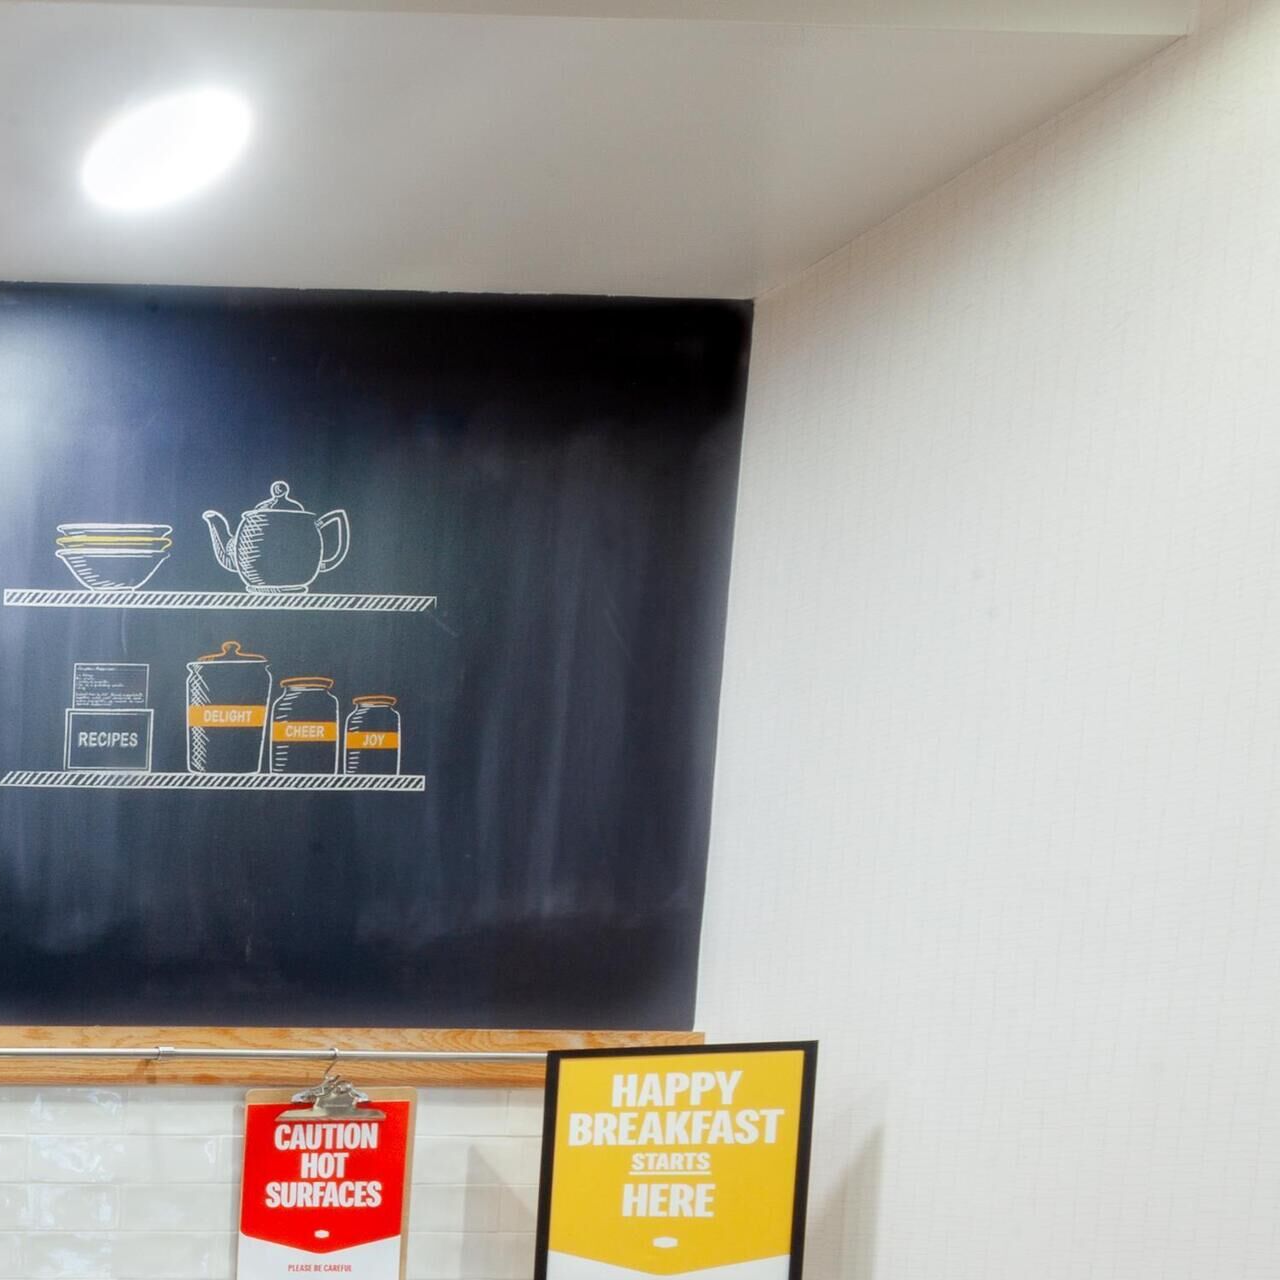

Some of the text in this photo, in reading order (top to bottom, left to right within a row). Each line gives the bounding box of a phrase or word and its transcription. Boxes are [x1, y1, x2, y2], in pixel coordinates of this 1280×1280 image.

[203, 709, 252, 724] DELIGHT
[78, 731, 139, 750] RECIPES
[285, 724, 325, 739] CHEER
[362, 733, 385, 747] JOY
[611, 1070, 743, 1108] HAPPY
[274, 1123, 379, 1151] CAUTION
[568, 1108, 785, 1147] BREAKFAST
[300, 1152, 349, 1179] HOT
[631, 1152, 711, 1171] STARTS
[265, 1181, 382, 1209] SURFACES
[621, 1183, 716, 1218] HERE
[288, 1264, 352, 1272] PLEASE BE CAREFUL
